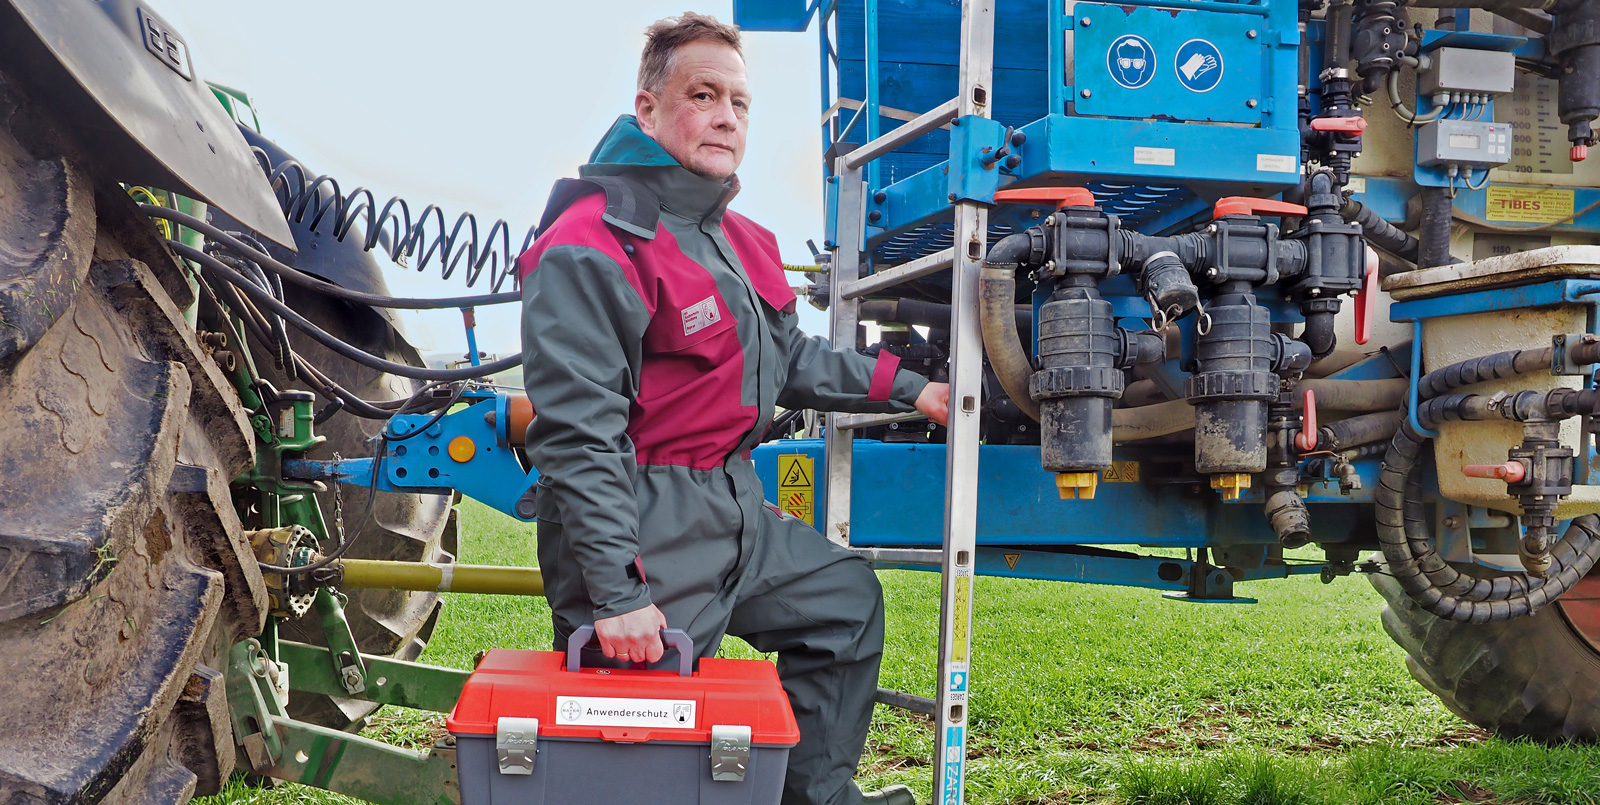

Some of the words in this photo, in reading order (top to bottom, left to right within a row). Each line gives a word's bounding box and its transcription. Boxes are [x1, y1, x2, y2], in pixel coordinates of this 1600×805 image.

[1494, 198, 1540, 210] TIBES
[1492, 246, 1511, 254] 1150
[586, 708, 668, 718] Anwenderschutz
